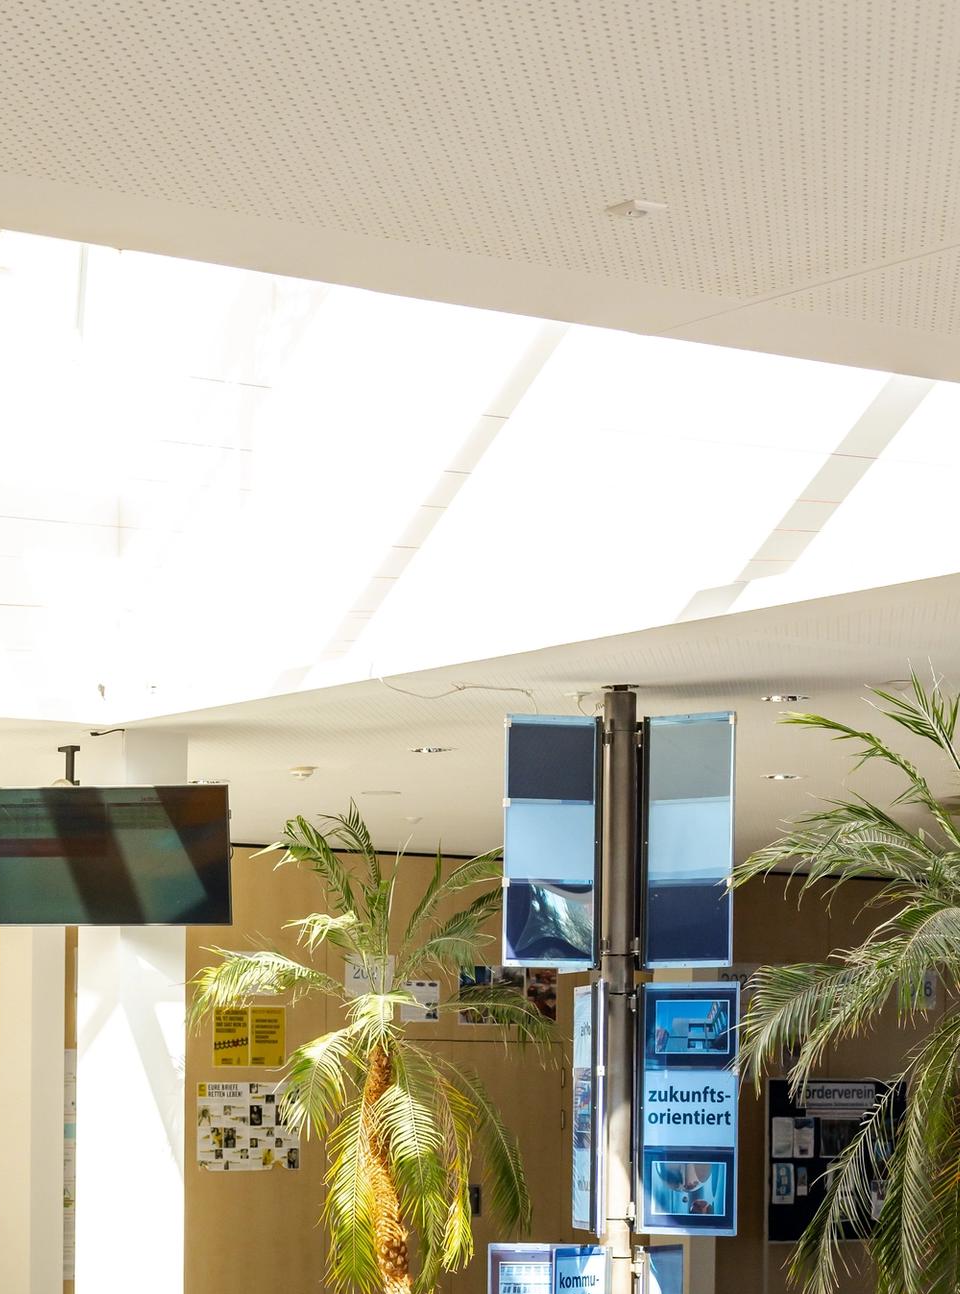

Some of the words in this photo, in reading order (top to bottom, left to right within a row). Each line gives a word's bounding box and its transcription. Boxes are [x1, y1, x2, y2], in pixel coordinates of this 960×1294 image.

[648, 1086, 731, 1103] zukunfts-
[648, 1109, 731, 1126] orientiert
[559, 1272, 600, 1289] kommu-
